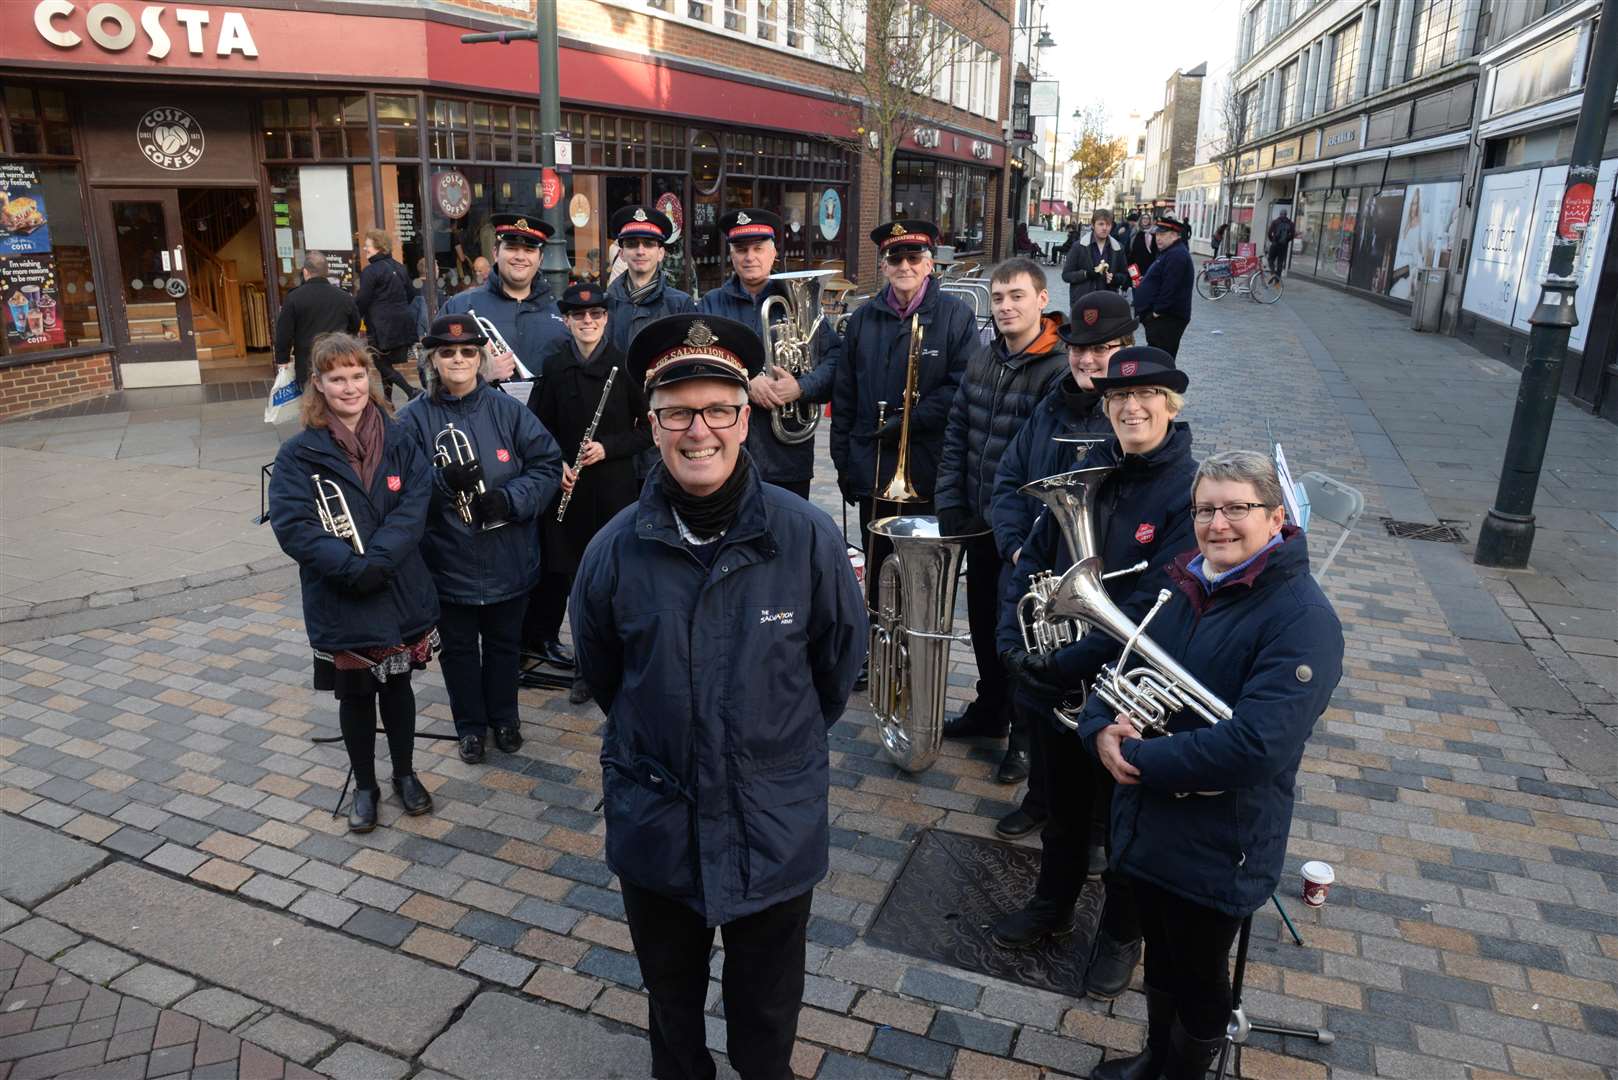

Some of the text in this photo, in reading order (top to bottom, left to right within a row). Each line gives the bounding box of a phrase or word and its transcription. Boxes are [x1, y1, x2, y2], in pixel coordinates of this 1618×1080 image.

[34, 0, 259, 59] COSTA
[145, 109, 191, 128] COSTA
[145, 144, 200, 168] COFFEE
[442, 175, 463, 188] COSTA
[442, 199, 469, 213] COFFEE
[11, 243, 32, 251] COSTA
[27, 336, 47, 344] COSTA
[670, 346, 724, 358] SALVATION
[760, 611, 794, 625] SALVATION
